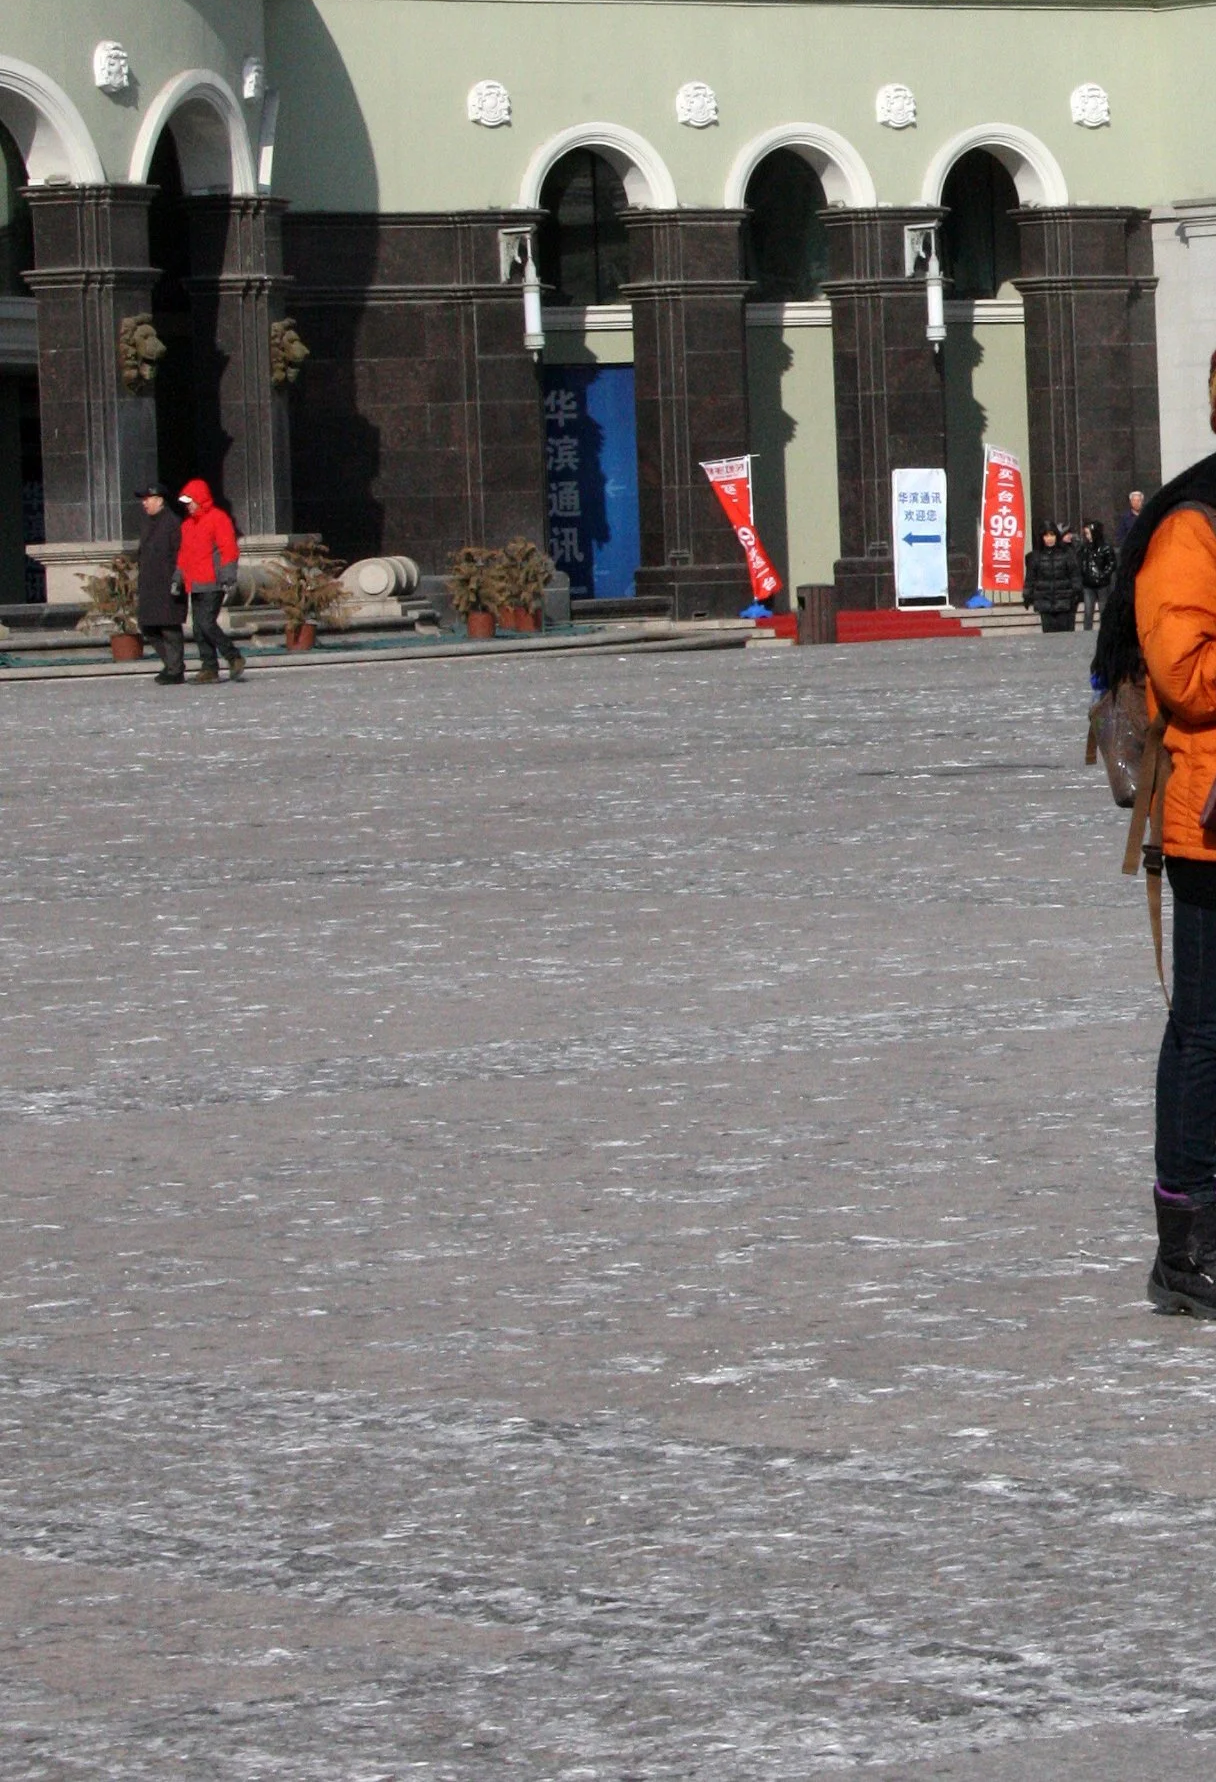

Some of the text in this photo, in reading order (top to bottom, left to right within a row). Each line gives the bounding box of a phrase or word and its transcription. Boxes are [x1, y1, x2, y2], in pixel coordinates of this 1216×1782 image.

[544, 388, 585, 563] 华滨通讯
[898, 491, 942, 505] 华滨通讯
[904, 509, 937, 522] 欢迎您
